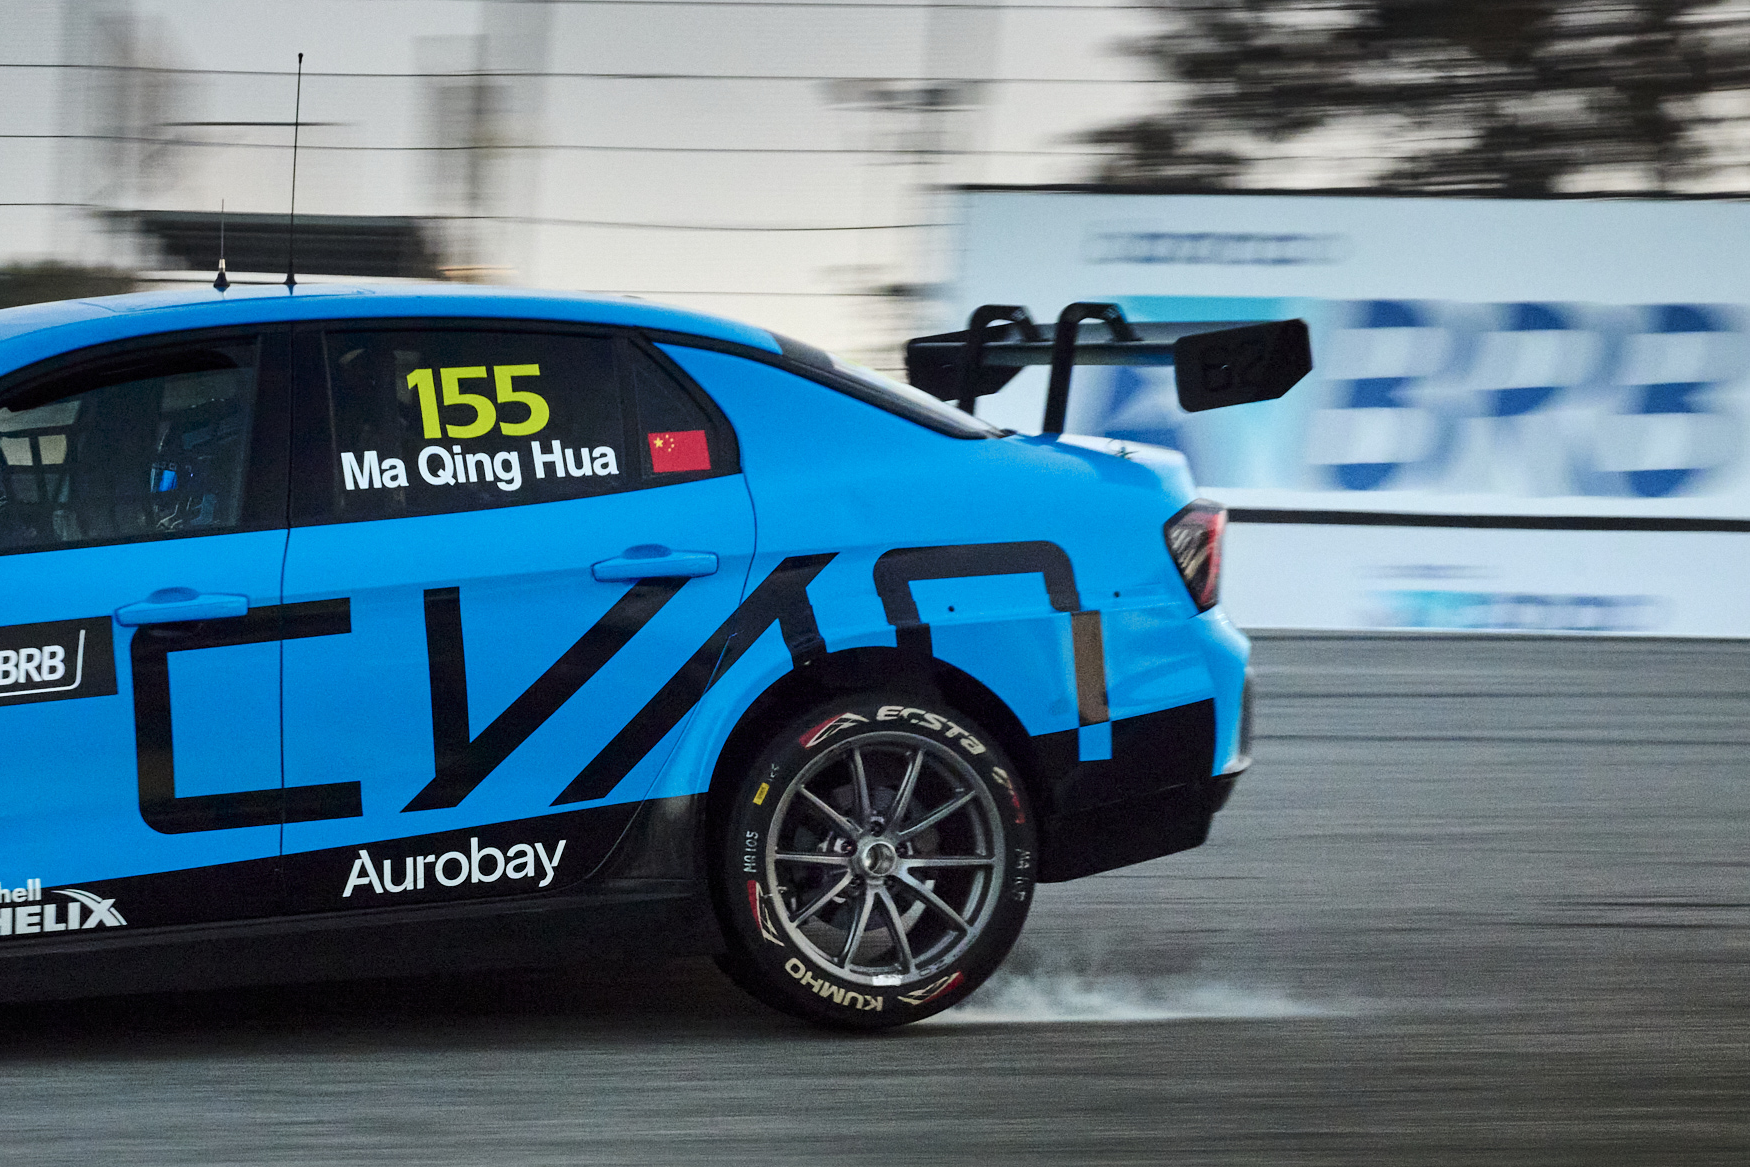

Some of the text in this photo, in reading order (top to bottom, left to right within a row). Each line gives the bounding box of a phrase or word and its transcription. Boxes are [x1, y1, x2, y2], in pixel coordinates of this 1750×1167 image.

[406, 363, 551, 439] 155
[341, 439, 619, 492] Ma Qing Hua
[342, 837, 566, 898] Aurobay
[784, 957, 884, 1012] KUMHO
